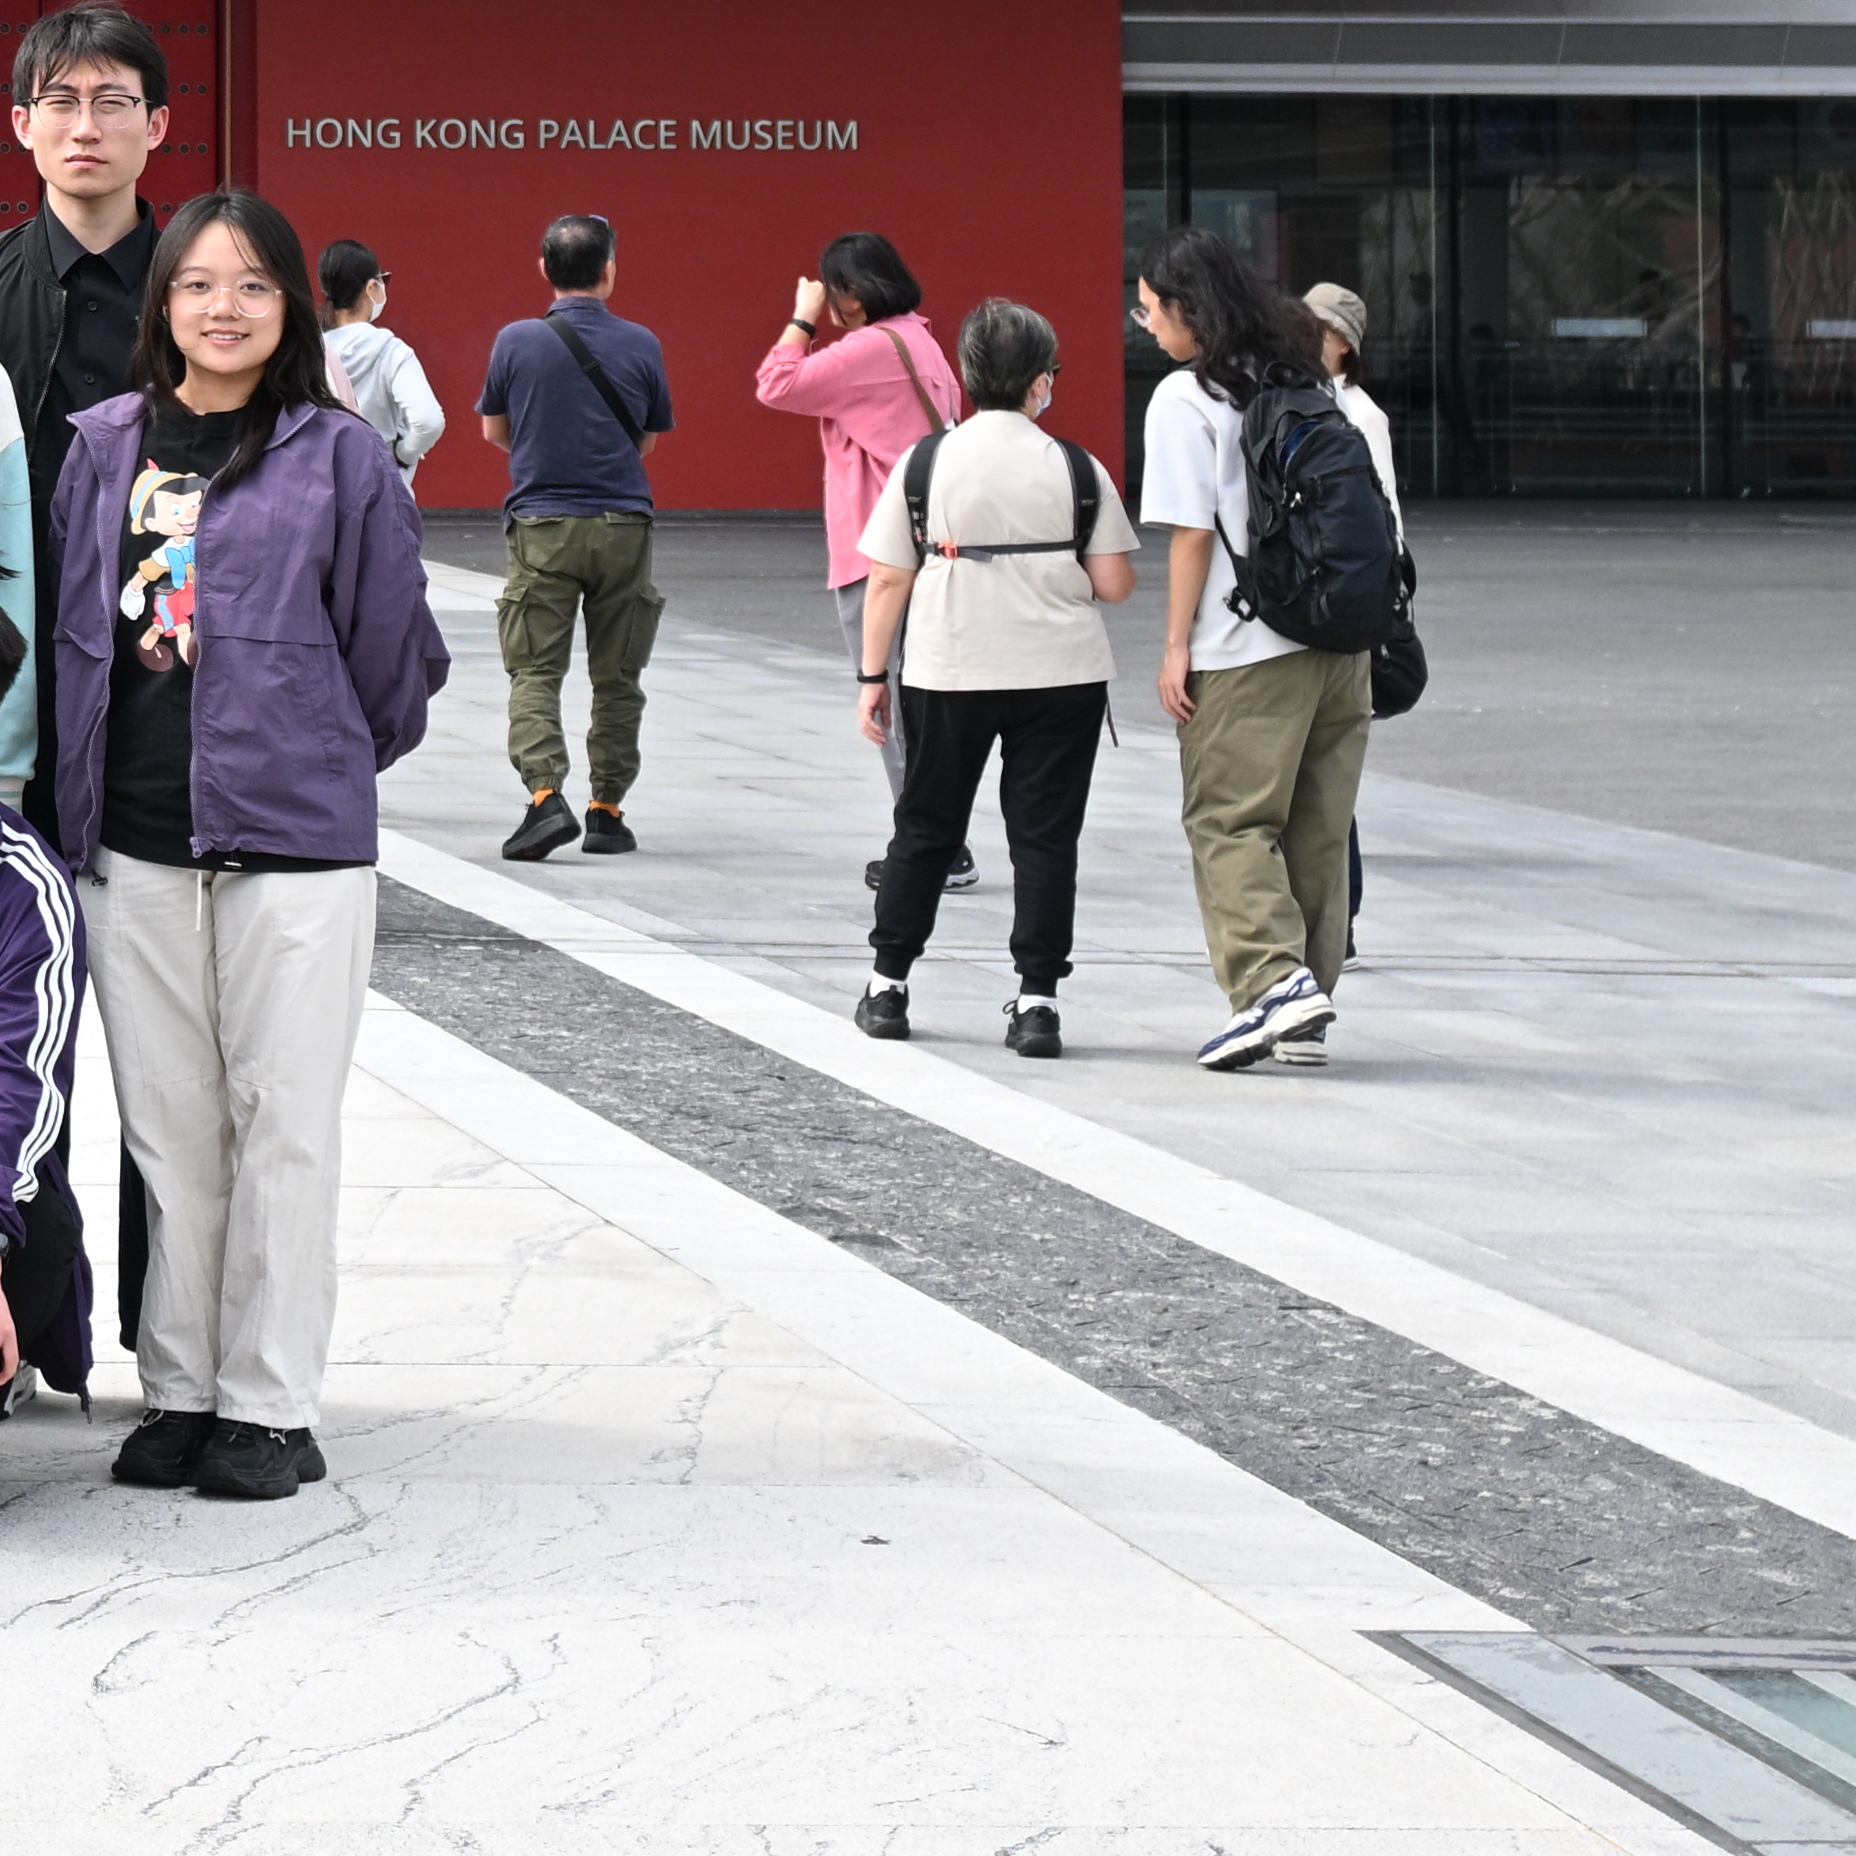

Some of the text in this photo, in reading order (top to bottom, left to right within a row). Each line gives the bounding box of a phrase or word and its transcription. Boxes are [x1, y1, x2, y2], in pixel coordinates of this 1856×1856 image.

[287, 118, 860, 151] HONG KONG PALACE MUSEUM
